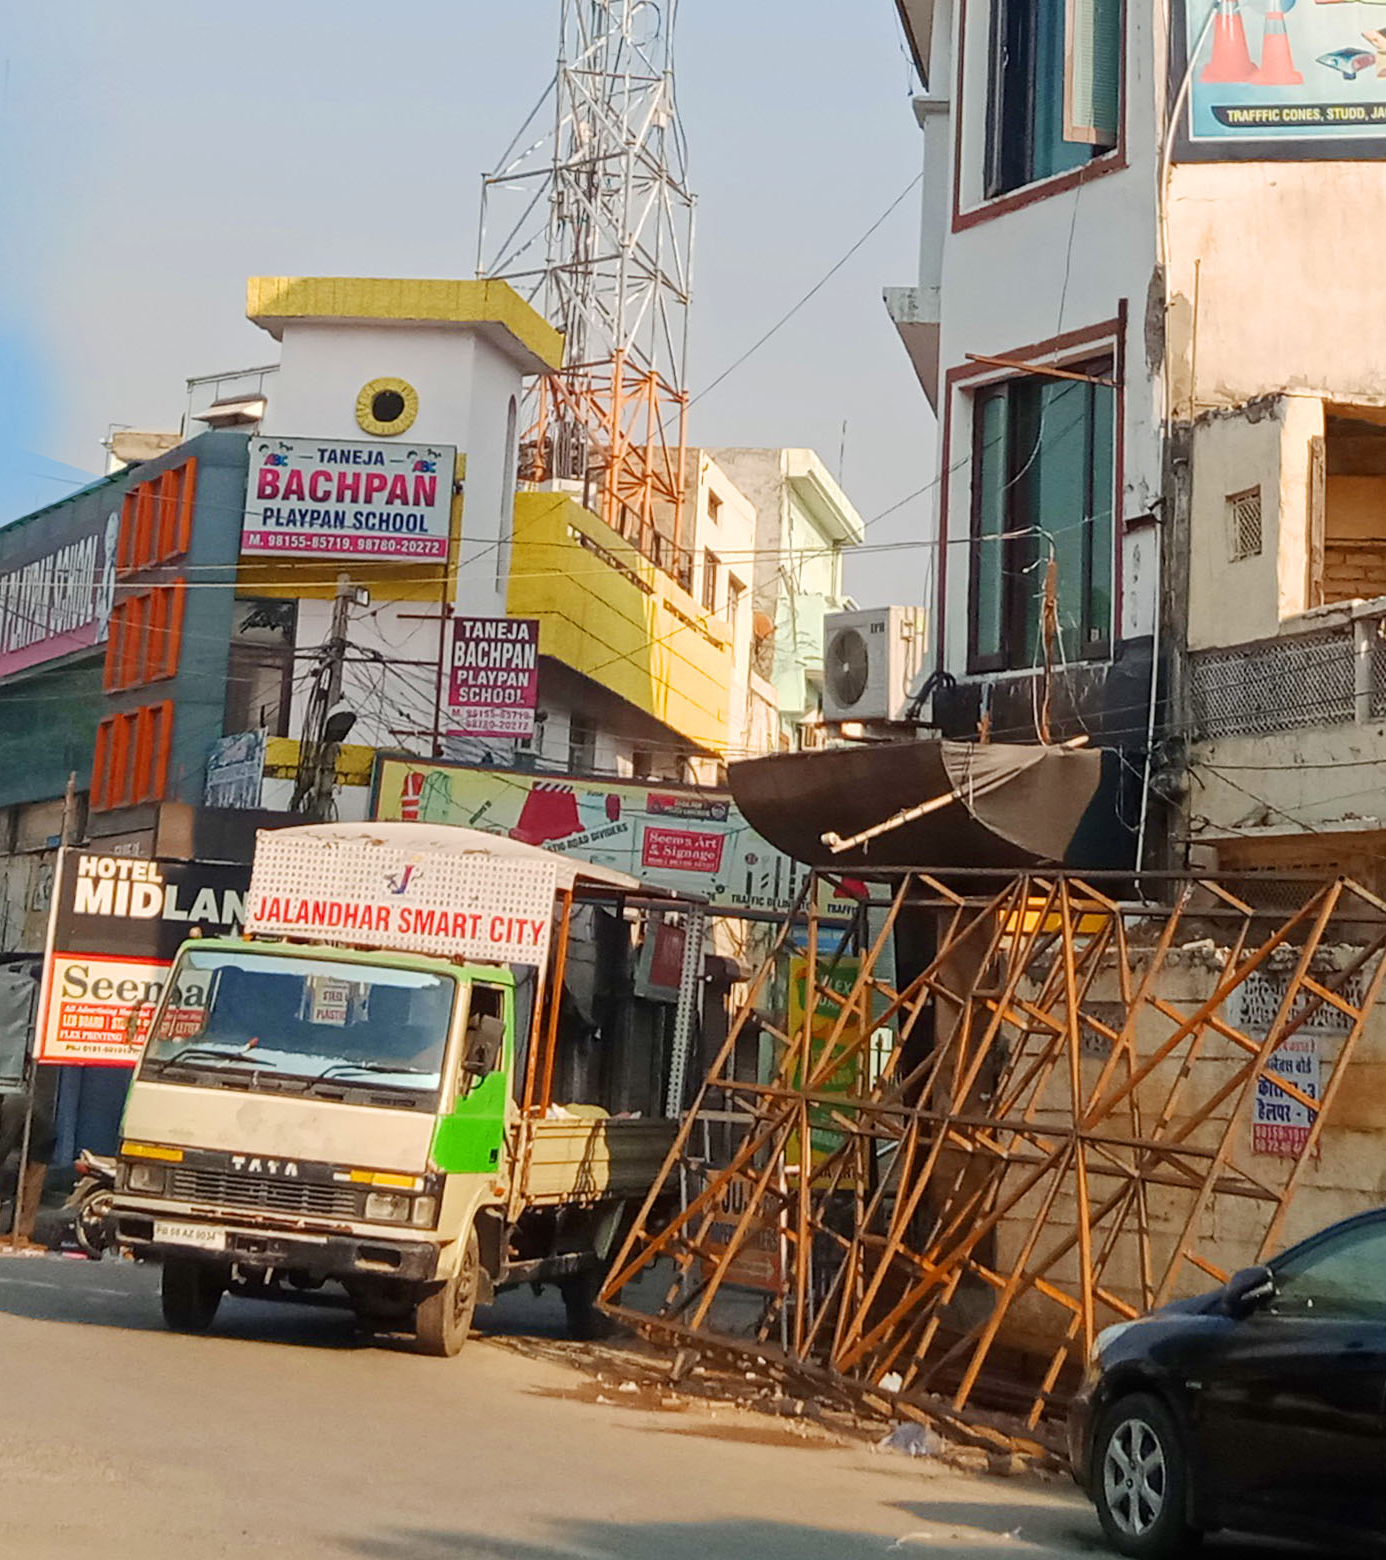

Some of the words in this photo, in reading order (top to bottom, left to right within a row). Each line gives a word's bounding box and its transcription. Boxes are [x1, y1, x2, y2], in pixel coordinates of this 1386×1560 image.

[1283, 107, 1323, 122] CONES,
[1326, 106, 1368, 122] STUDD,
[317, 448, 385, 466] TANEJA
[256, 468, 438, 507] BACHPAN
[263, 507, 346, 530] PLAYPAN
[353, 511, 429, 533] SCHOOL
[249, 534, 264, 546] M.
[357, 538, 440, 554] 98780-20272
[463, 621, 530, 640] TANEJA
[454, 641, 536, 670] BACHPAN
[456, 670, 530, 687] PLAYPAN
[459, 687, 525, 704] SCHOOL
[649, 831, 693, 847] Seema
[694, 836, 718, 849] Art
[662, 845, 716, 862] Signage
[78, 855, 164, 884] HOTEL
[253, 896, 391, 931] JALANDHAR
[397, 907, 482, 940] SMART
[489, 915, 545, 946] CITY
[231, 1155, 299, 1177] TATA
